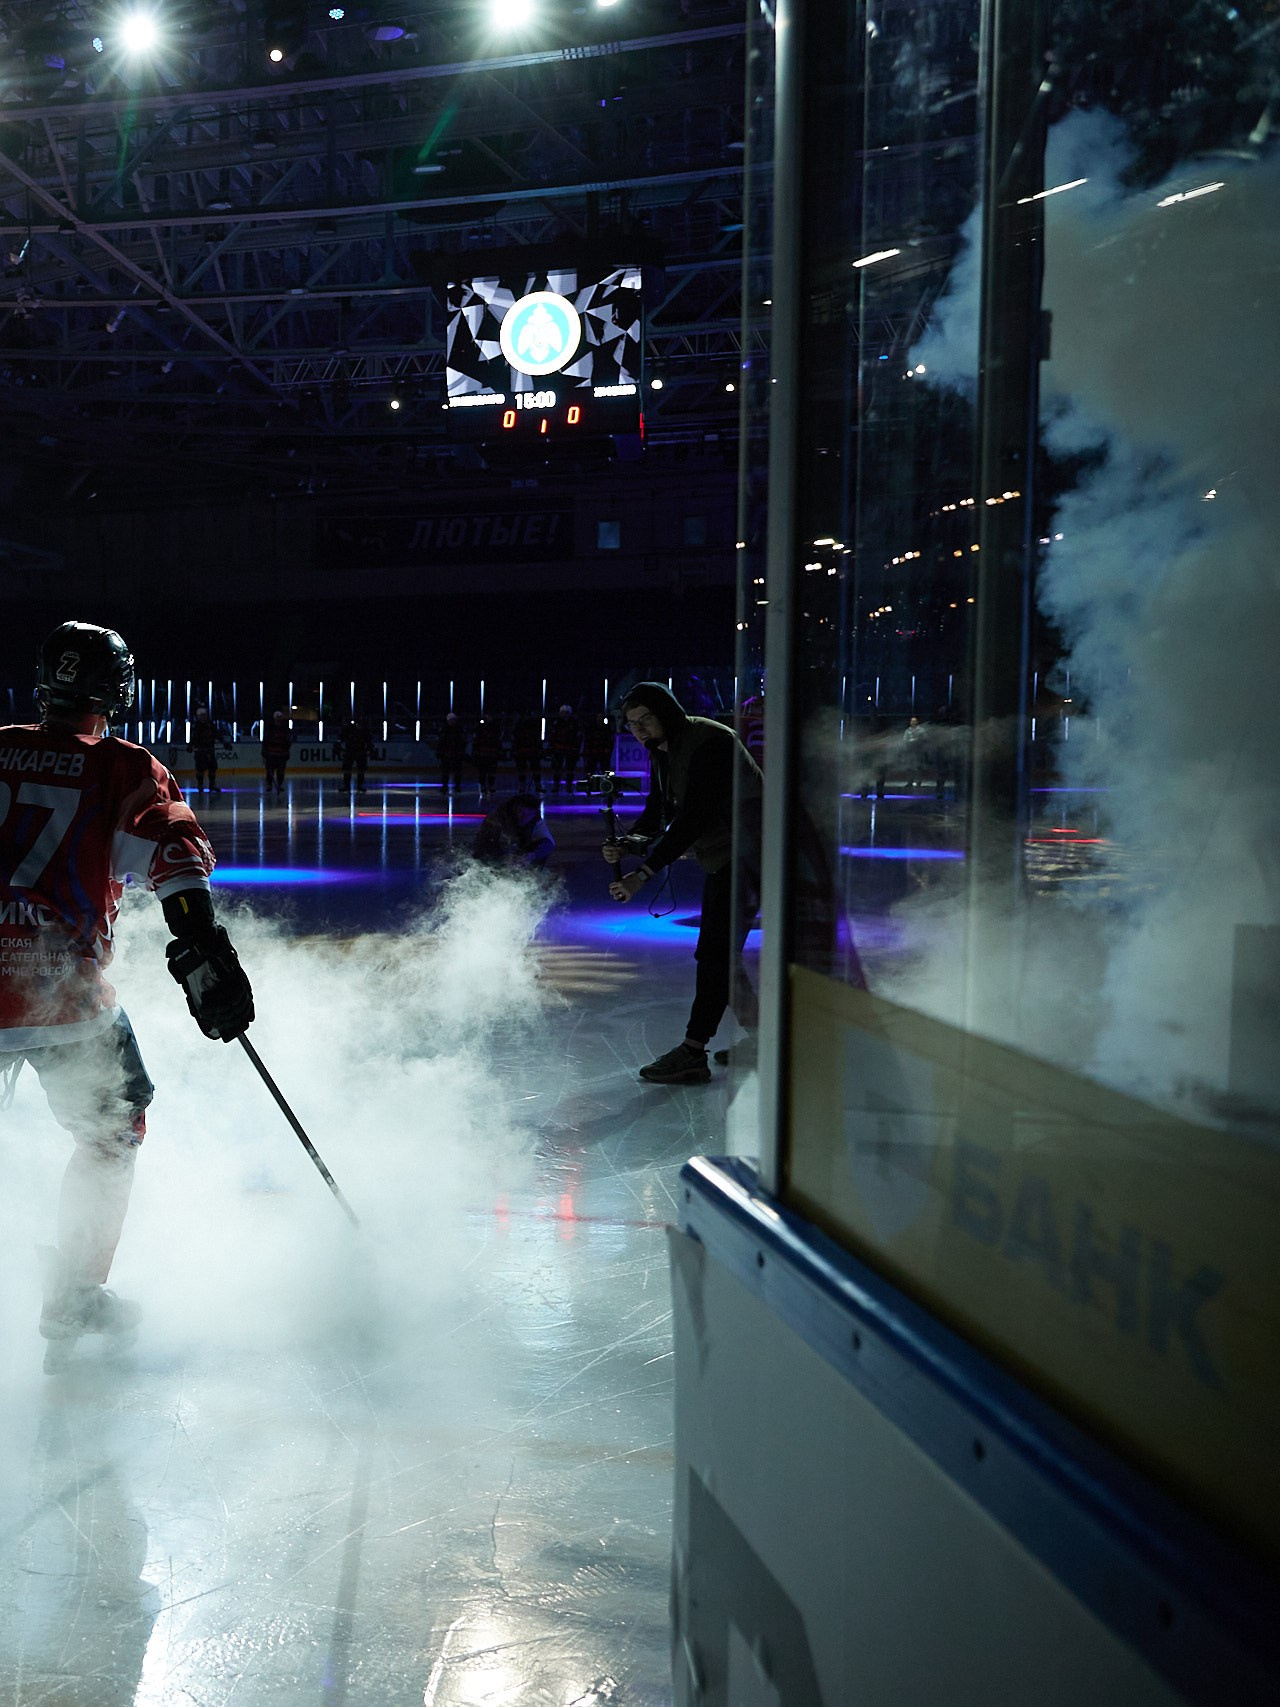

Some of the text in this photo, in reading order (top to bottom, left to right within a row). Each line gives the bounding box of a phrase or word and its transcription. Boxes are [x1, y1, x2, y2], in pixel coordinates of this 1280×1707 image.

[503, 410, 516, 428] 0
[567, 406, 580, 424] 0
[409, 515, 559, 548] ЛЮТЫЕ!
[951, 1135, 1228, 1393] БАНК
